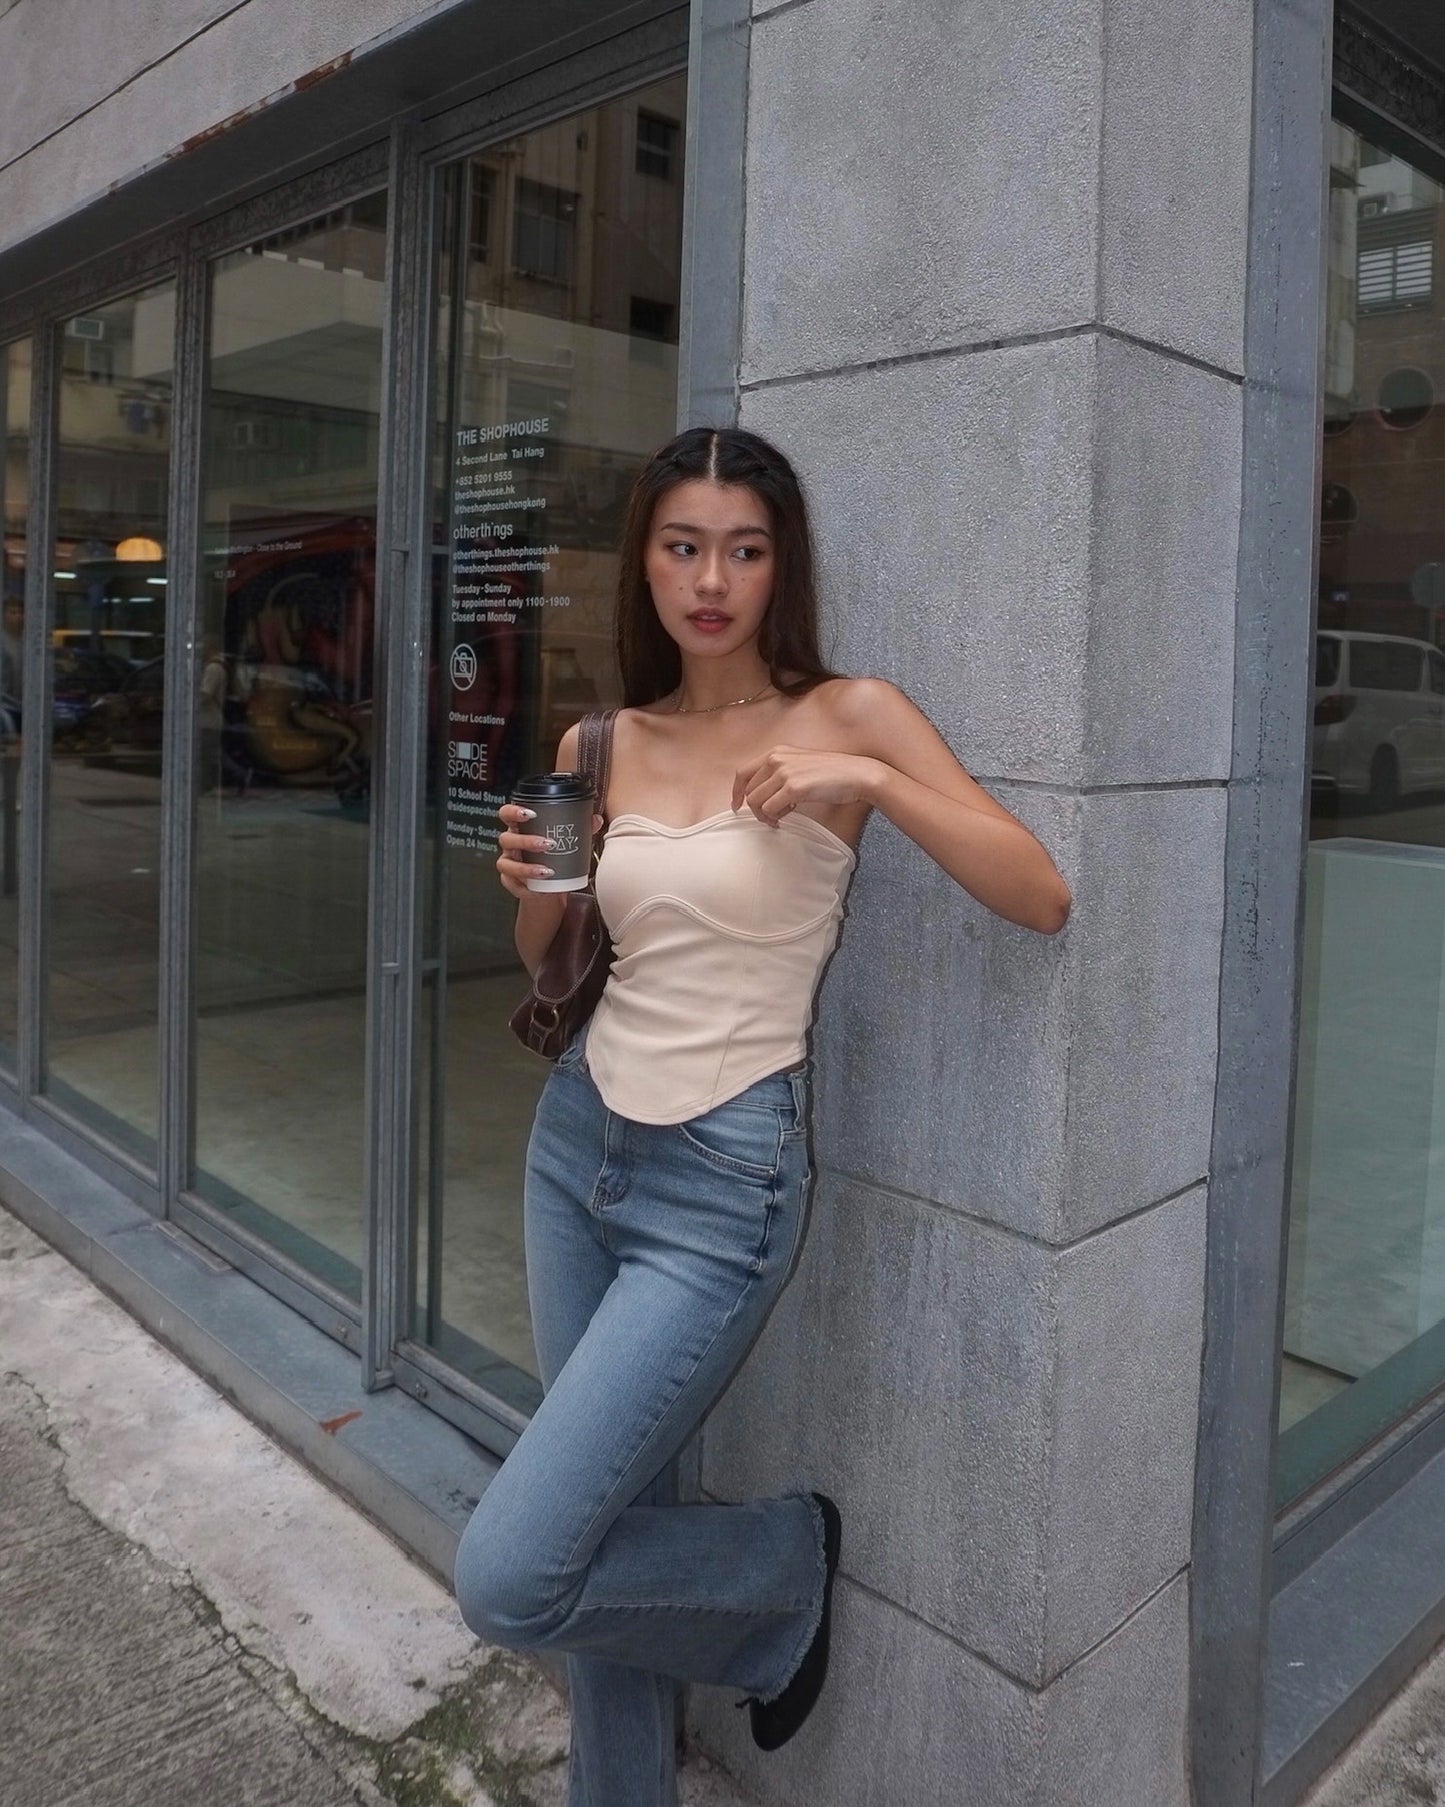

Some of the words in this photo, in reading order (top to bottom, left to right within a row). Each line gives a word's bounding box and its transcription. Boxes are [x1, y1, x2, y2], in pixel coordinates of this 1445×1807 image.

[457, 429, 477, 446] THE
[480, 418, 549, 442] SHOPHOUSE
[462, 453, 488, 466] Second
[489, 452, 508, 462] Lane
[512, 449, 523, 459] Tai
[524, 447, 544, 458] Hang
[474, 474, 492, 484] 5201
[493, 471, 513, 481] 9555
[455, 484, 515, 501] theshophouse.hk
[454, 497, 546, 515] @theshophousehongkong
[453, 544, 559, 560] otherthings.theshophouse.hk
[453, 560, 551, 575] @theshophouseotherthings
[451, 598, 460, 609] by
[461, 598, 506, 608] appointment
[507, 597, 523, 608] only
[451, 611, 475, 623] Closed
[476, 613, 486, 623] on
[487, 611, 516, 623] Monday
[449, 711, 469, 722] Other
[470, 713, 505, 726] Locations
[447, 760, 487, 781] SPACE
[448, 787, 457, 798] 10
[458, 788, 482, 801] School
[483, 791, 506, 805] Street
[546, 824, 575, 839] HEY
[446, 834, 465, 846] Open
[466, 837, 476, 848] 24
[477, 839, 498, 852] hours
